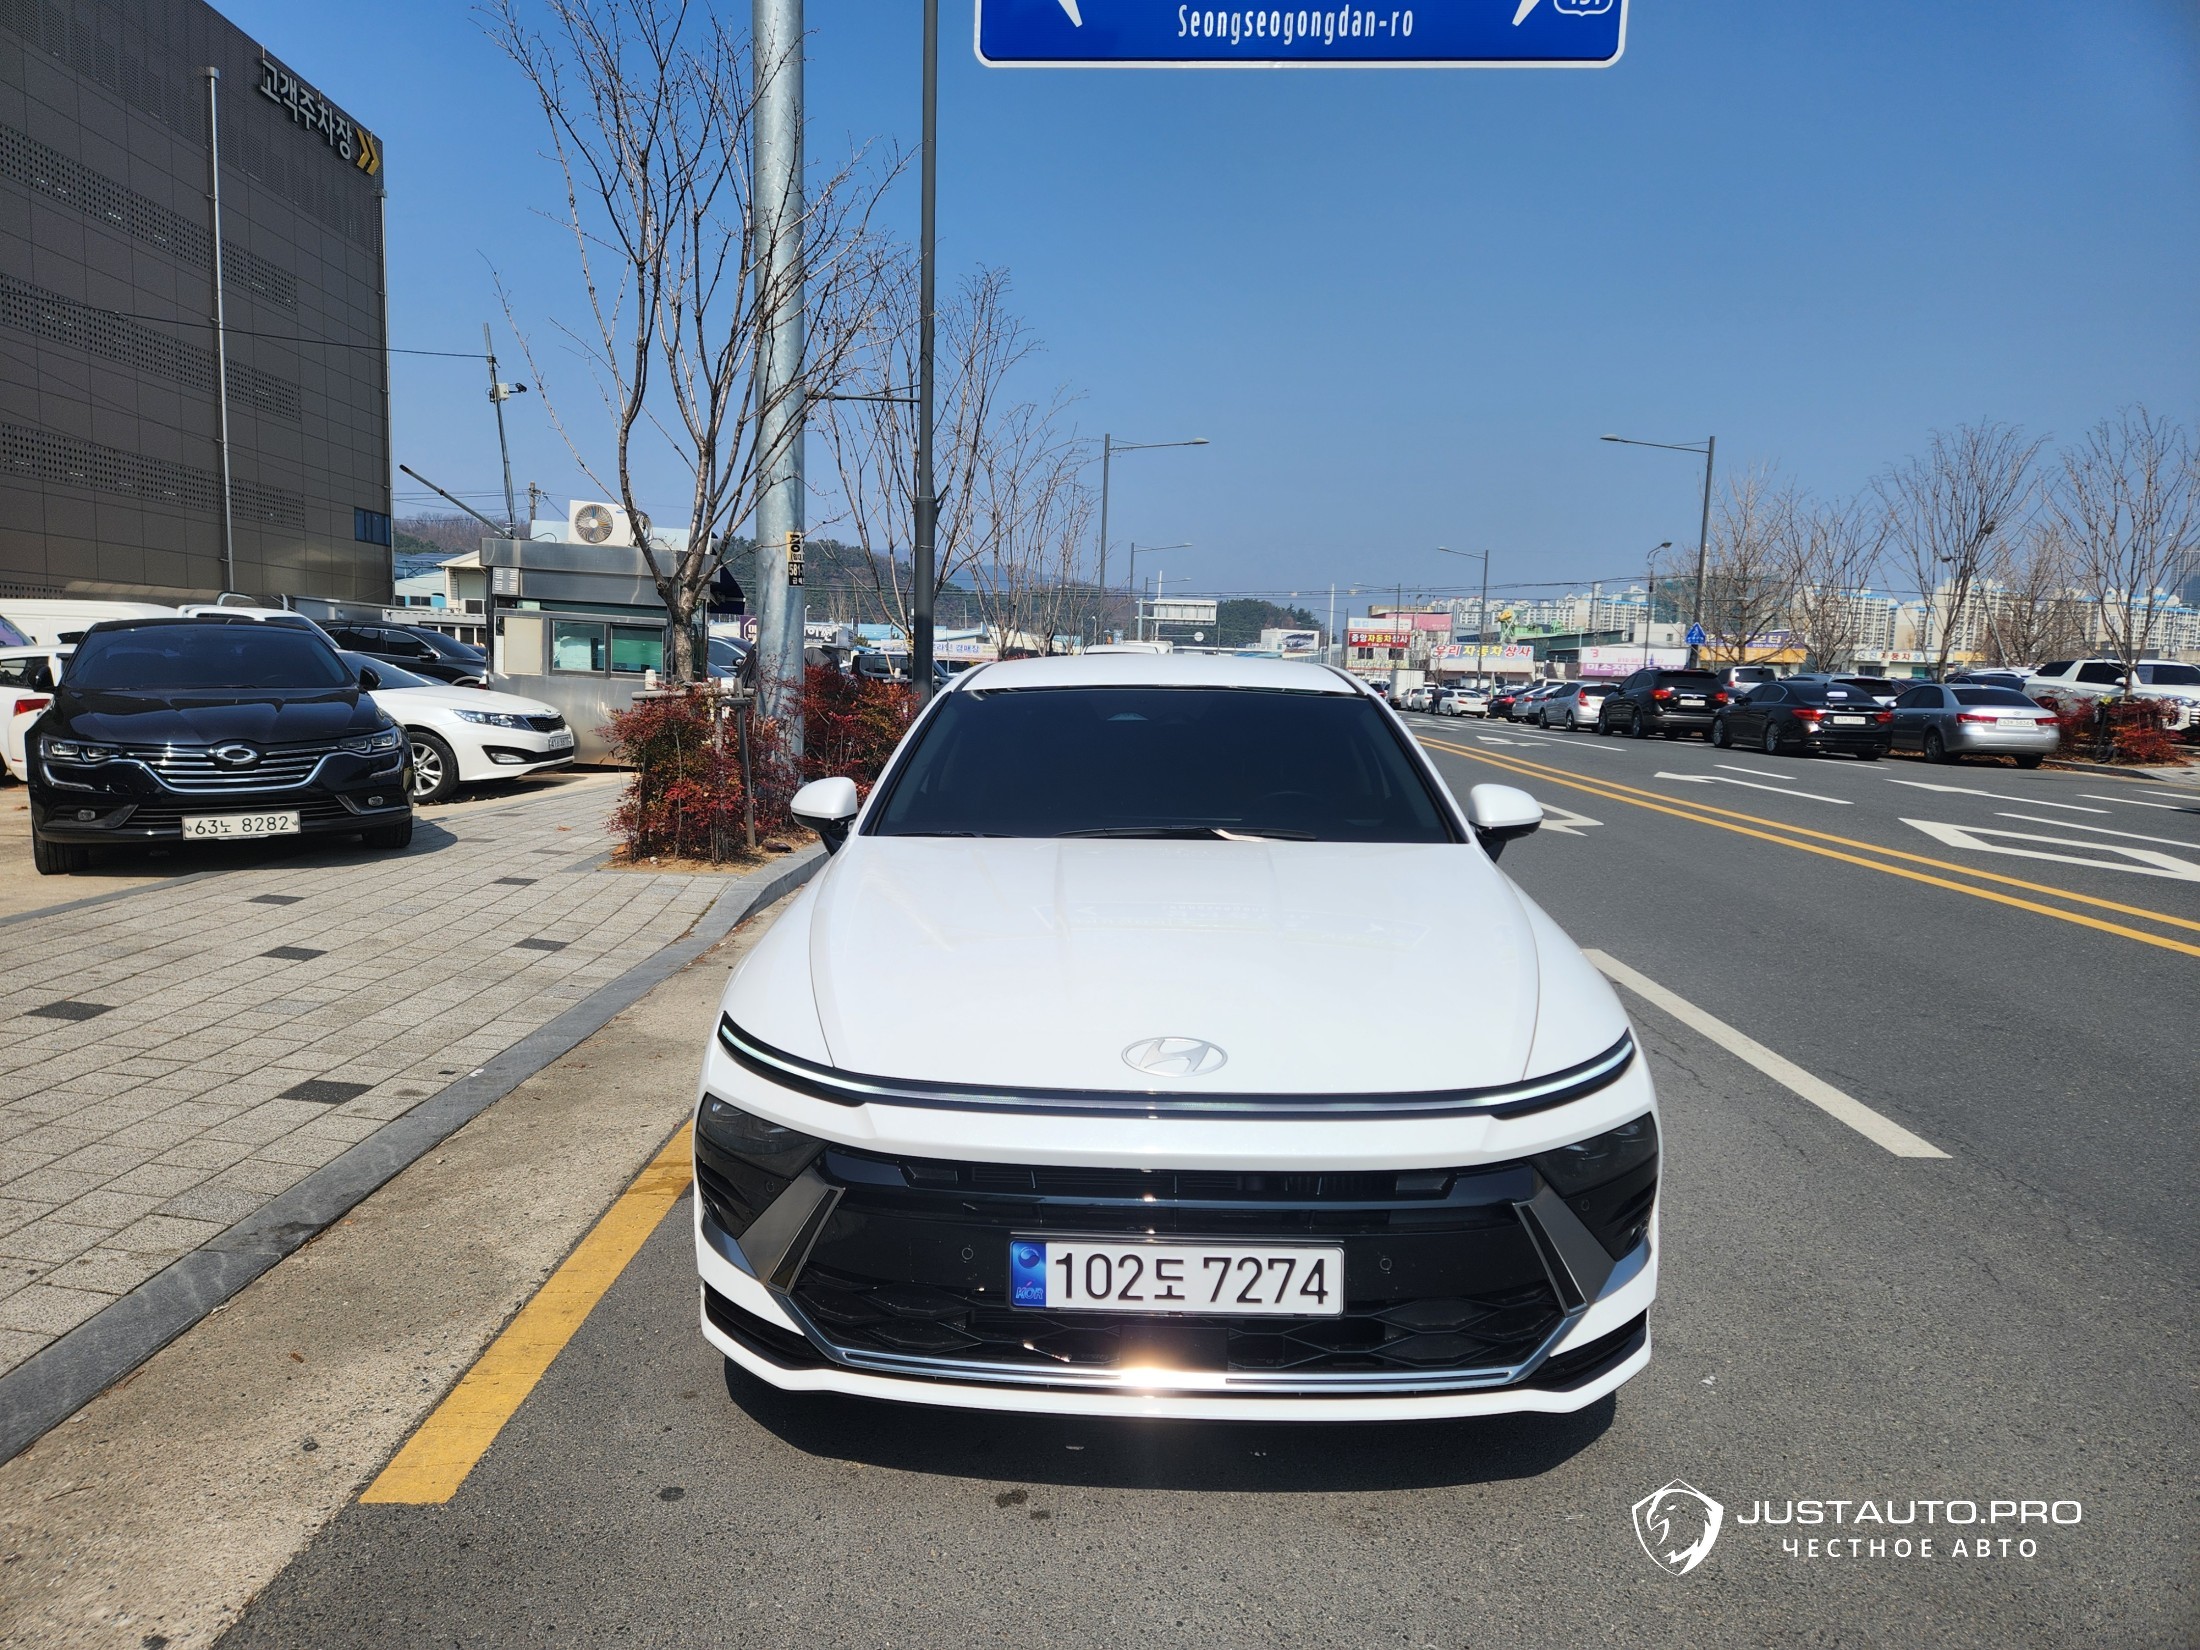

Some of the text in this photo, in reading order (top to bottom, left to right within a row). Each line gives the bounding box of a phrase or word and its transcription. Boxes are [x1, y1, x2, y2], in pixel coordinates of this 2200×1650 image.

[1178, 4, 1414, 45] Seongseogongdan-ro
[259, 58, 353, 160] 고객주차장
[194, 815, 289, 835] 63노 8282
[1055, 1251, 1329, 1305] 102도 7274
